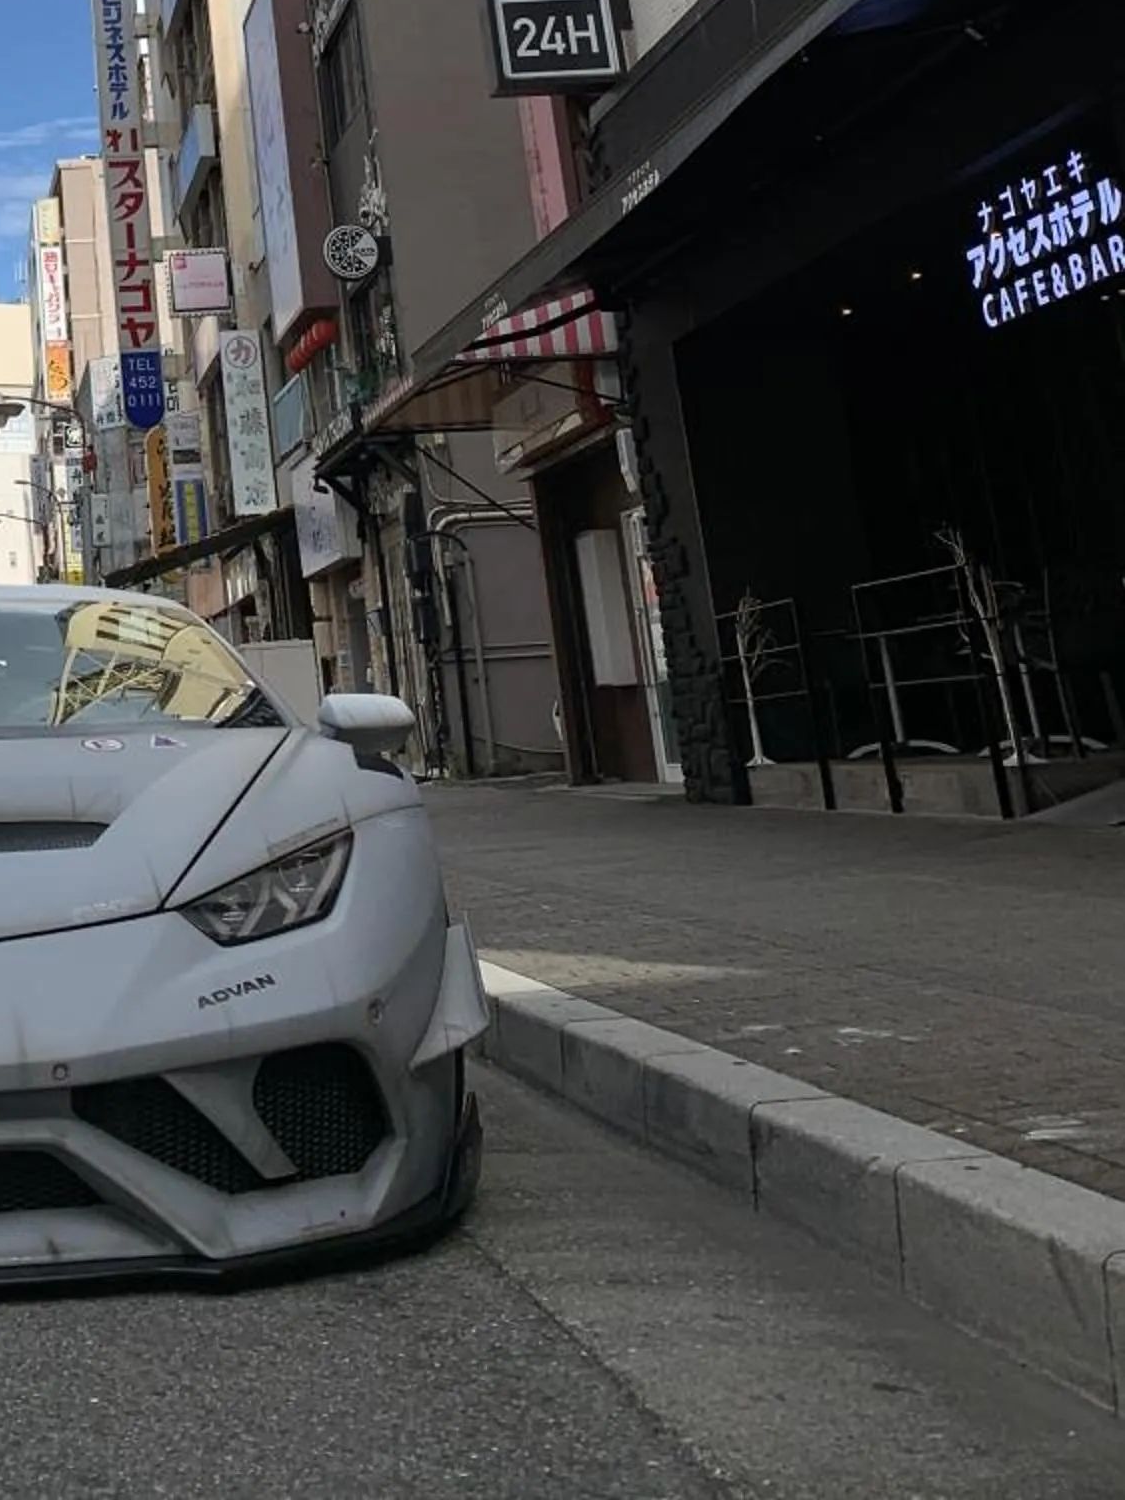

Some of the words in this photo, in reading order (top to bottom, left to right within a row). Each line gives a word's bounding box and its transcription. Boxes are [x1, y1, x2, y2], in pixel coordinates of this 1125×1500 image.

[512, 14, 600, 58] 24H
[966, 177, 1122, 289] アクセスホテル
[108, 159, 155, 349] スターナゴヤ
[982, 234, 1125, 328] CAFE&BAR
[128, 358, 155, 372] TEL
[129, 375, 157, 389] 452
[127, 393, 161, 408] 0111
[198, 974, 276, 1009] ADVAN
